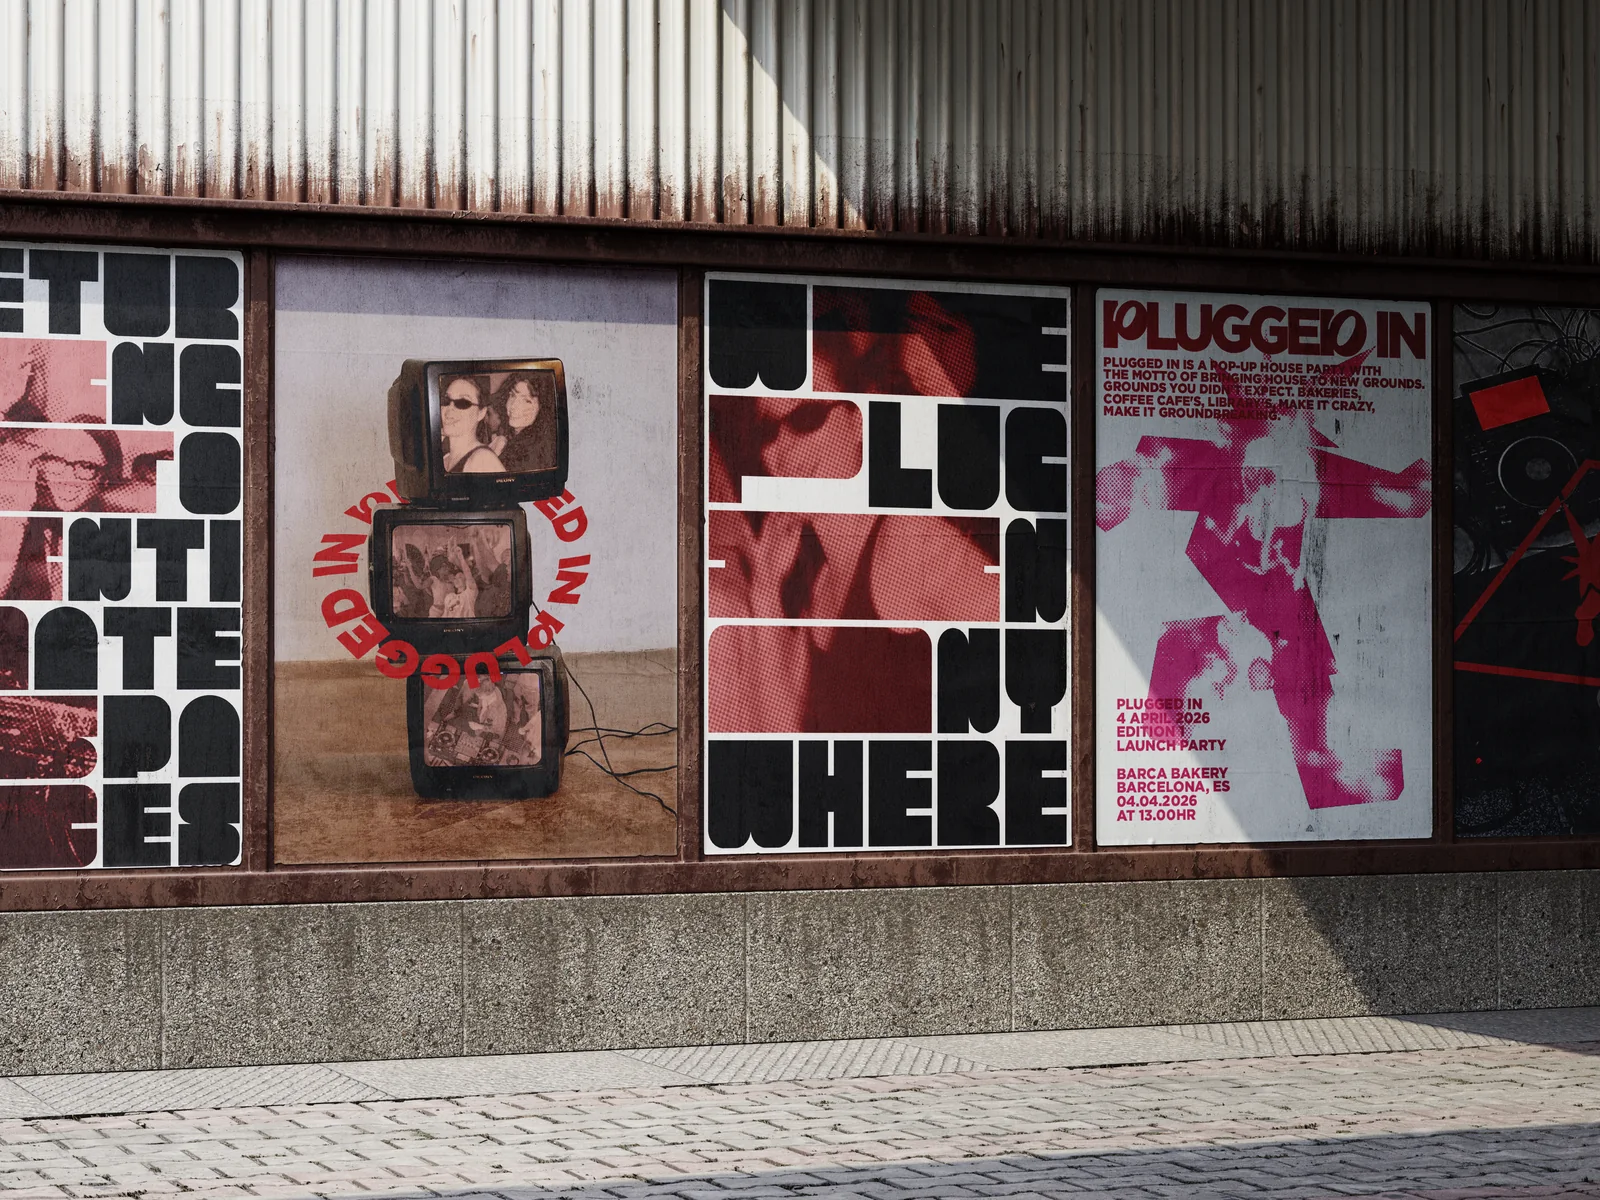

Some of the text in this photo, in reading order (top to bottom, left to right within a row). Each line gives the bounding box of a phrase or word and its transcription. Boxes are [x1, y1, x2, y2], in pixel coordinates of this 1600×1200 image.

[1103, 299, 1426, 359] PLUGGED IN
[1103, 357, 1381, 376] PLUGGED IN IS A POP-UP HOUSE PARTY WITH
[1103, 369, 1425, 389] THE MOTTO OF BRINGING HOUSE TO NEW GROUNDS.
[1103, 381, 1166, 393] GROUNDS
[1169, 383, 1196, 394] YOU
[1245, 386, 1295, 397] EXPECT.
[1297, 387, 1361, 400] BAKERIES,
[1103, 394, 1153, 405] COFFEE
[1157, 395, 1205, 408] CAFE'S,
[1279, 399, 1314, 410] MAKE
[1317, 400, 1329, 410] IT
[1332, 401, 1375, 414] CRAZY,
[1103, 406, 1281, 422] MAKE IT GROUNDBREAKING.
[547, 554, 591, 604] IN
[312, 534, 565, 690] PLUGGED IN
[1117, 698, 1202, 710] PLUGGED IN
[1117, 712, 1210, 724] 4 APRIL 2026
[1117, 726, 1185, 737] EDITION 1
[1117, 739, 1226, 751] LAUNCH PARTY
[1117, 767, 1228, 779] BARCA BAKERY
[708, 739, 1067, 848] WHERE
[1117, 781, 1230, 794] BARCELONA, ES
[1117, 795, 1197, 807] 04.04.2026
[1117, 809, 1196, 821] AT 13.00HR
